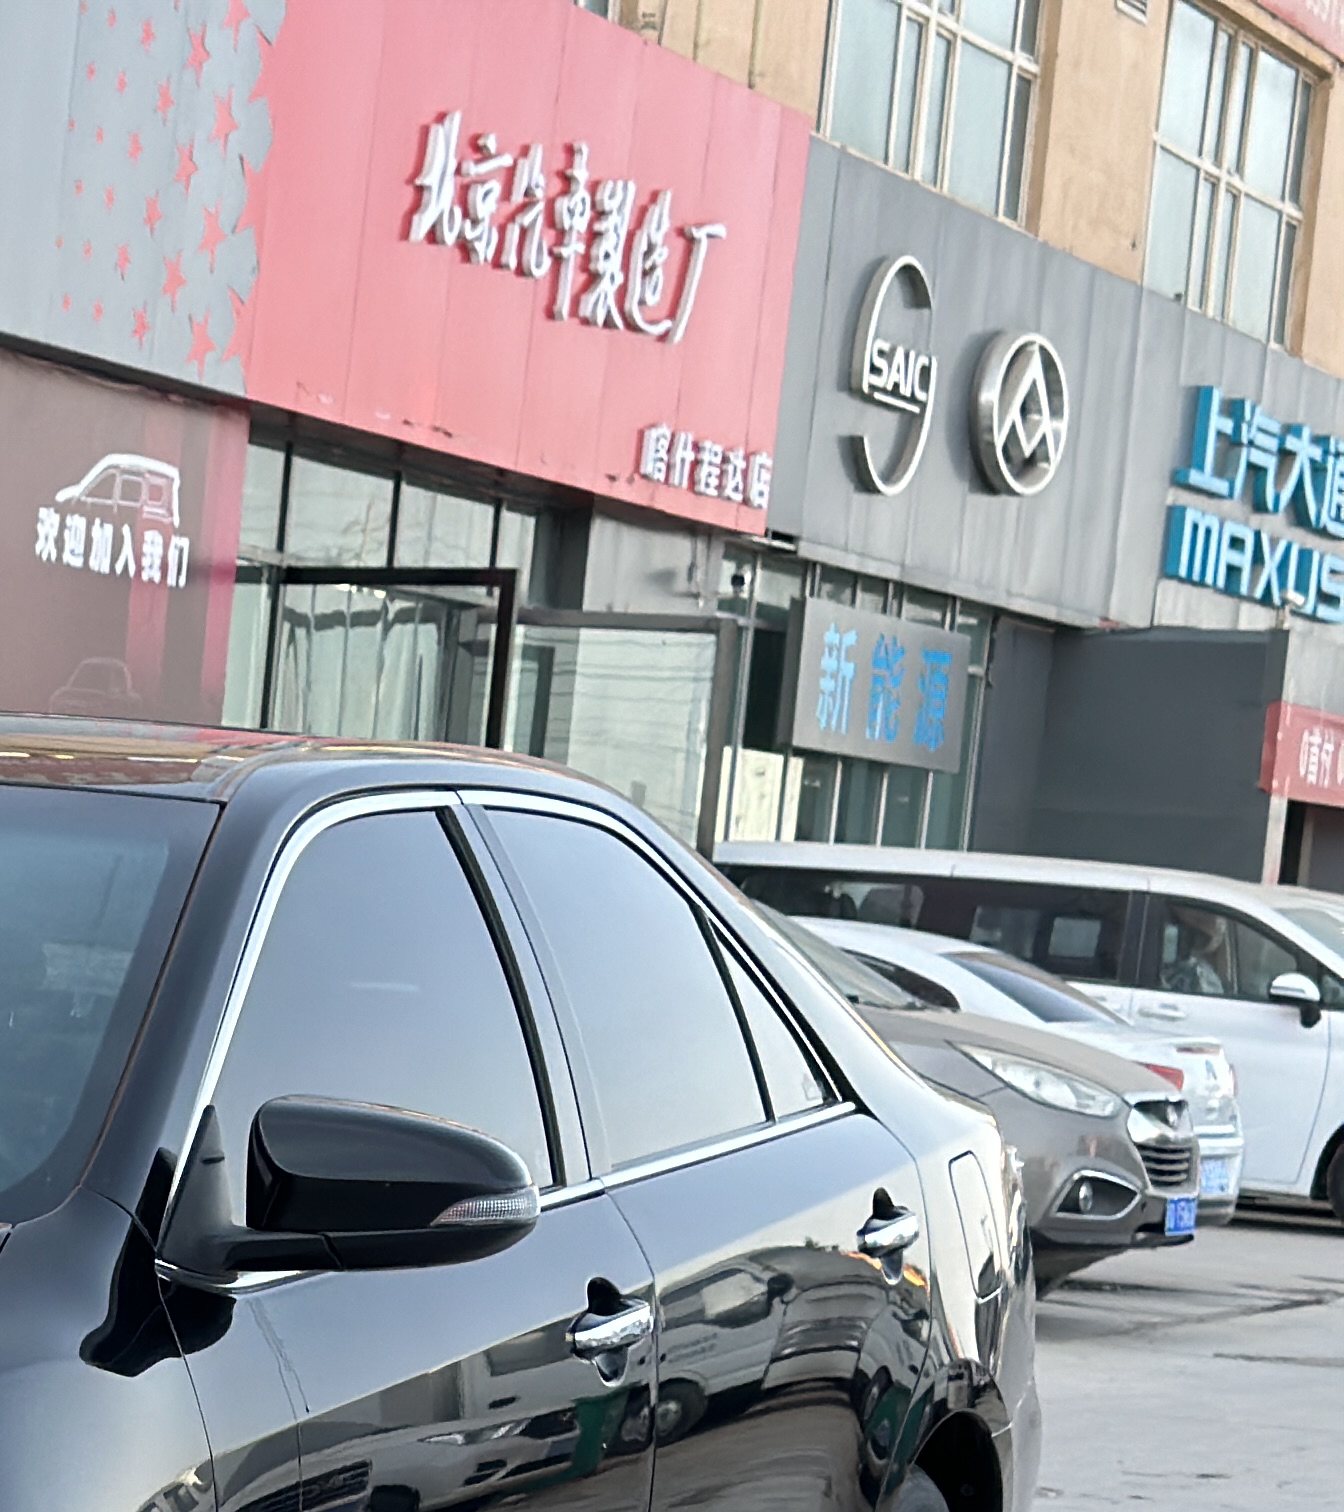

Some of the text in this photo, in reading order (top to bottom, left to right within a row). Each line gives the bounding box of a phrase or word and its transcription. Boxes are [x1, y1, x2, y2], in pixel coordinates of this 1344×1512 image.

[868, 338, 929, 403] SAIC
[35, 506, 190, 588] 欢迎加入我们
[1168, 505, 1344, 625] MAXUS
[815, 622, 953, 752] 新能源
